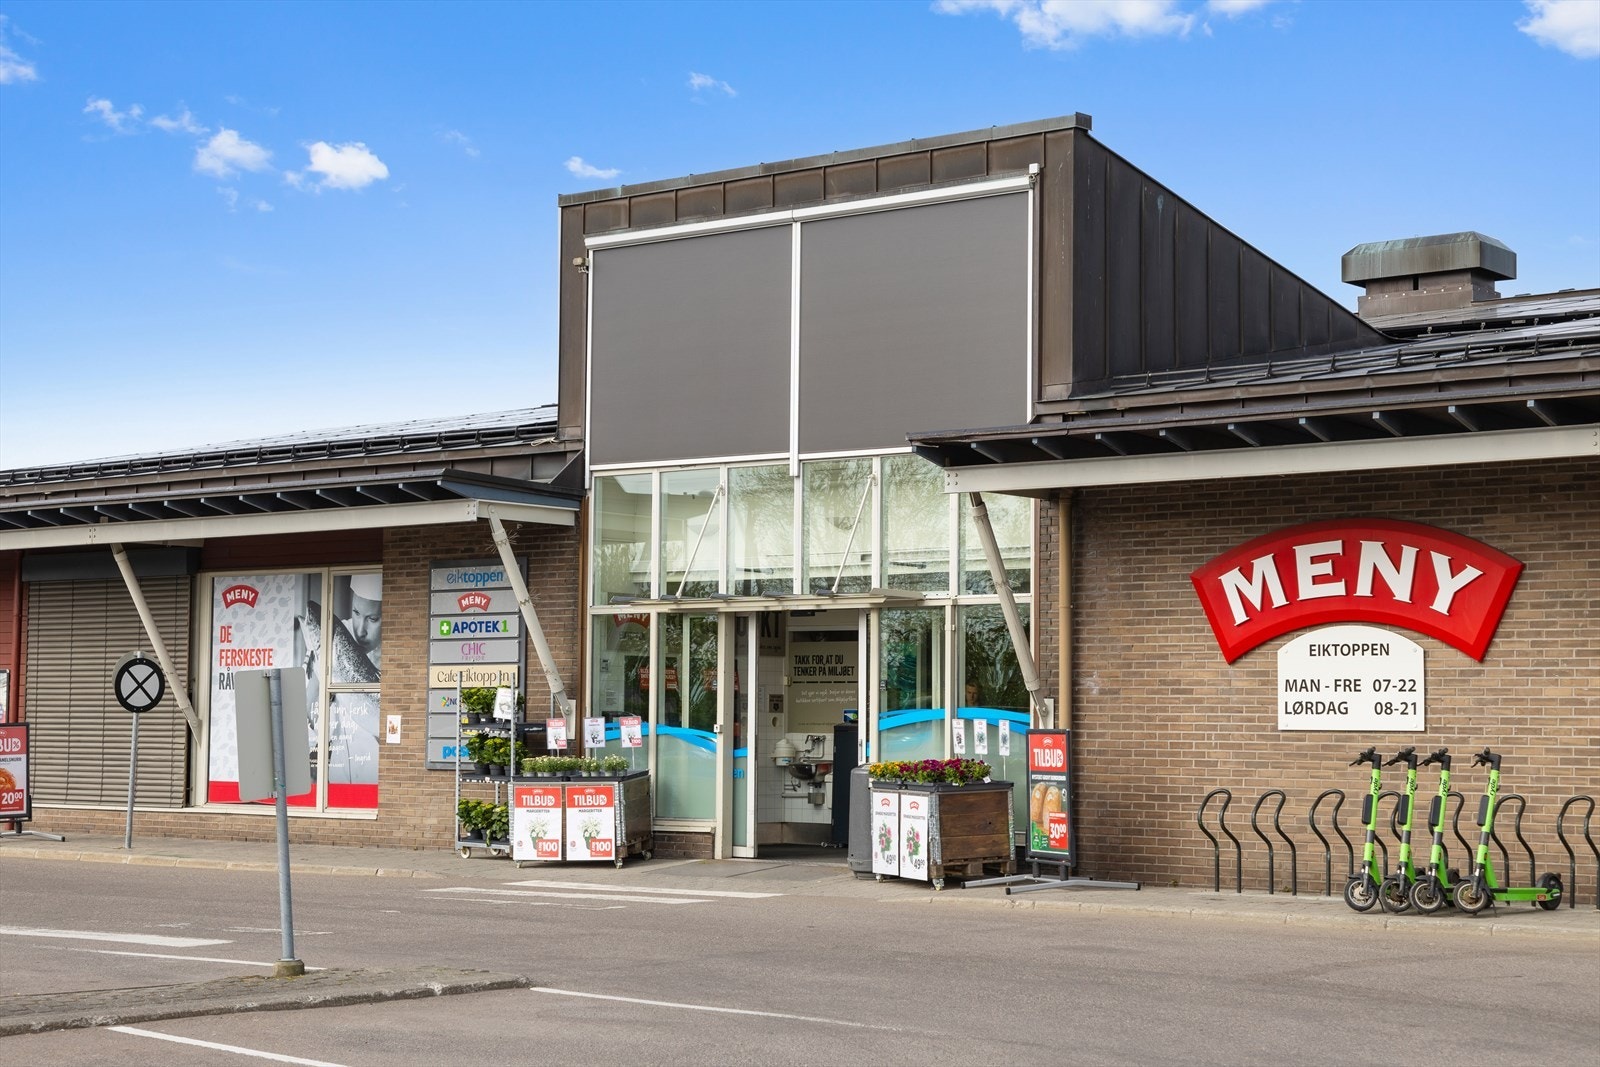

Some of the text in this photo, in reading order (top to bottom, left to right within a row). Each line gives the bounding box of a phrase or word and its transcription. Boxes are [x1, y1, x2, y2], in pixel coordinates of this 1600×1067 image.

[446, 569, 504, 587] eiktoppen
[1218, 540, 1483, 626] MENY
[226, 589, 255, 603] MENY
[461, 596, 487, 607] MENY
[452, 619, 509, 634] APOTEK 1
[219, 625, 232, 643] DE
[461, 642, 486, 656] CHIC
[1309, 643, 1390, 657] EIKTOPPEN
[219, 648, 273, 667] FERSKESTE
[794, 654, 844, 665] TAKK FOR AT DU
[437, 671, 458, 683] Cafe
[793, 663, 855, 677] TENKER PÅ MILJØET
[1284, 679, 1321, 693] MAN
[1333, 679, 1362, 693] FRE
[1372, 679, 1417, 693] 07-22
[1284, 700, 1418, 716] LØRDAG 08-21
[1033, 748, 1064, 767] TILBUD
[521, 795, 555, 806] TILBUD
[573, 794, 608, 806] TILBUD
